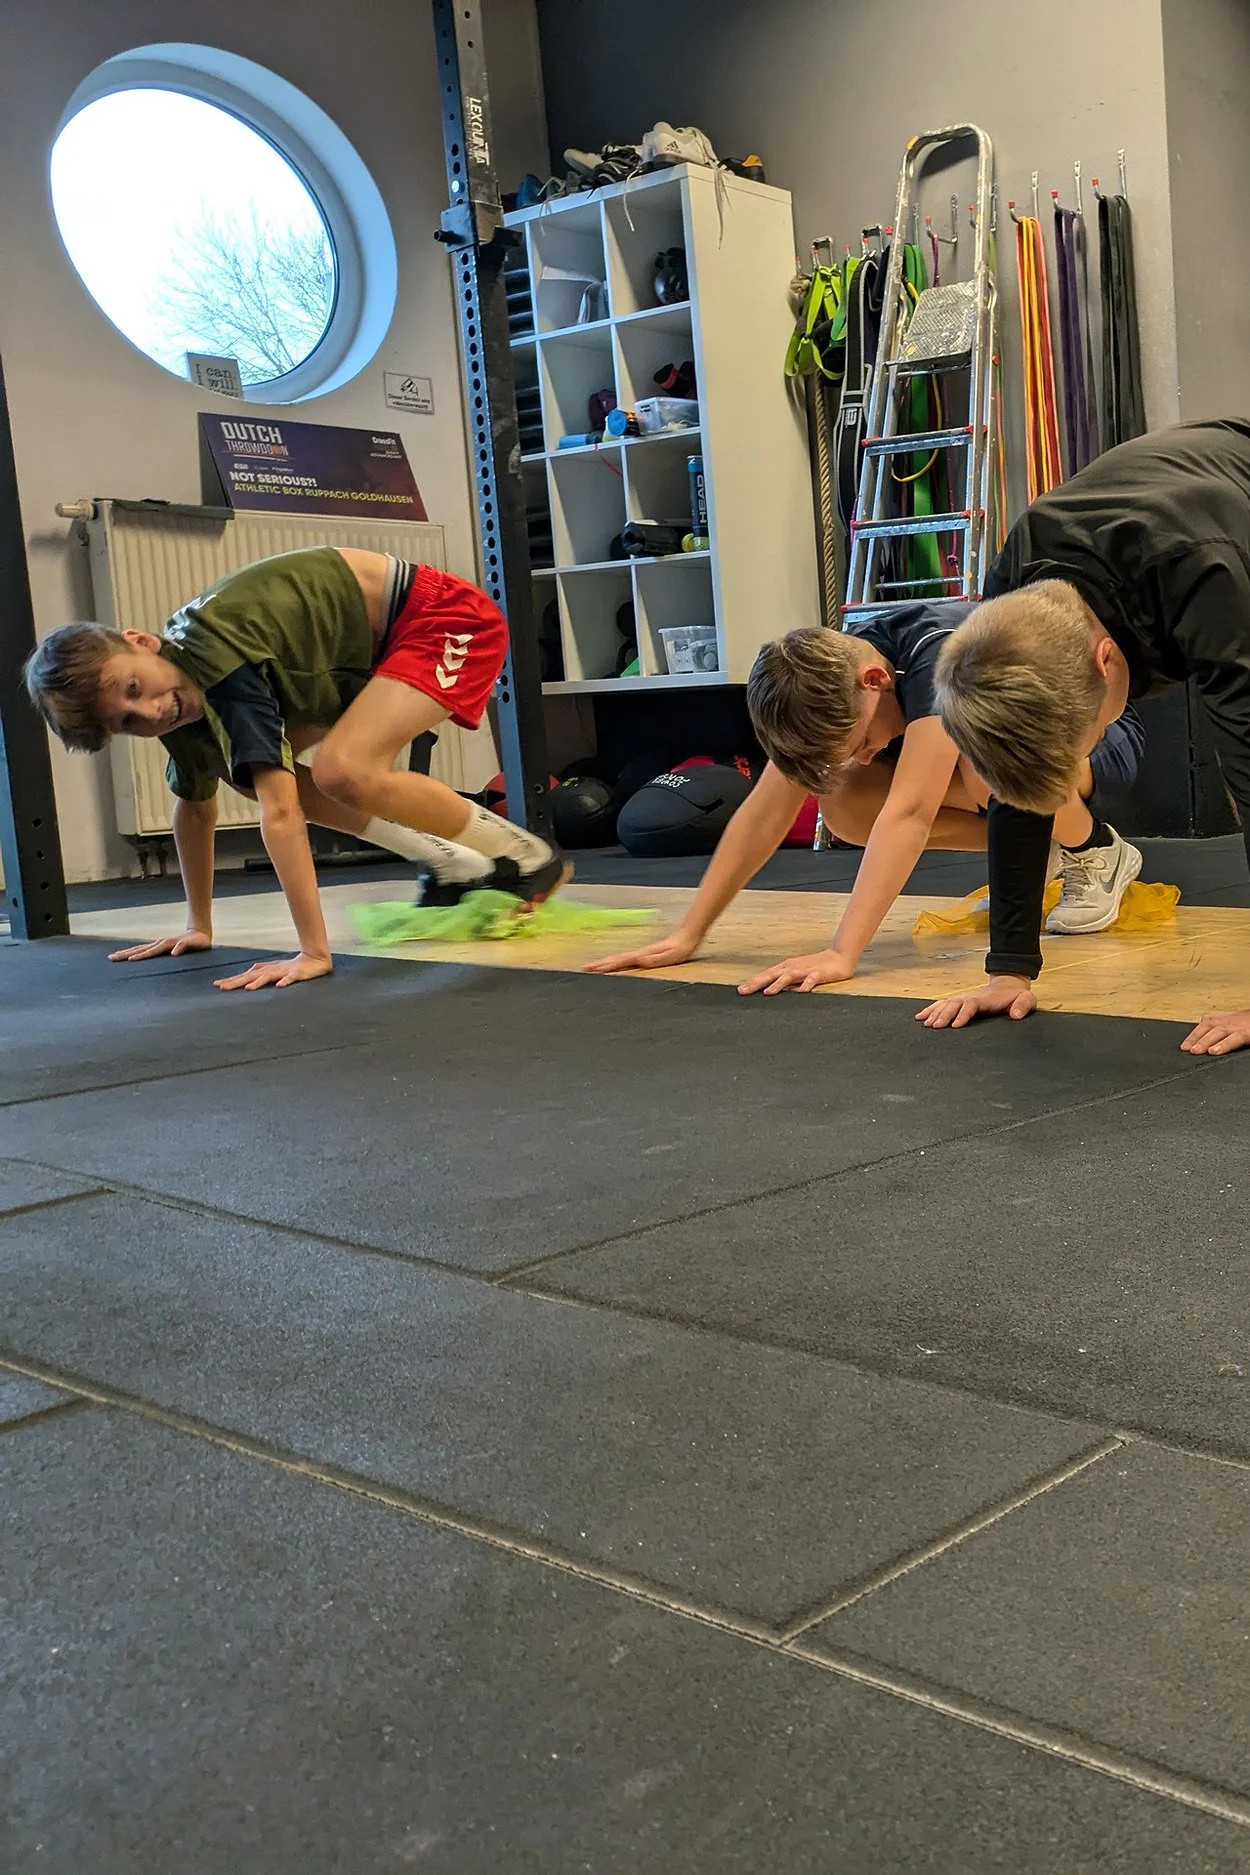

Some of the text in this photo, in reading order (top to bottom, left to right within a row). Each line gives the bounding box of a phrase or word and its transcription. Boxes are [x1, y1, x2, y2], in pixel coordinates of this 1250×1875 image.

[220, 421, 283, 444] DUTCH
[229, 471, 318, 487] NOT SERIOUS?!
[234, 483, 414, 504] ATHLETIC BOX RUPPACH GOLDHAUSEN
[696, 474, 707, 524] HEAD
